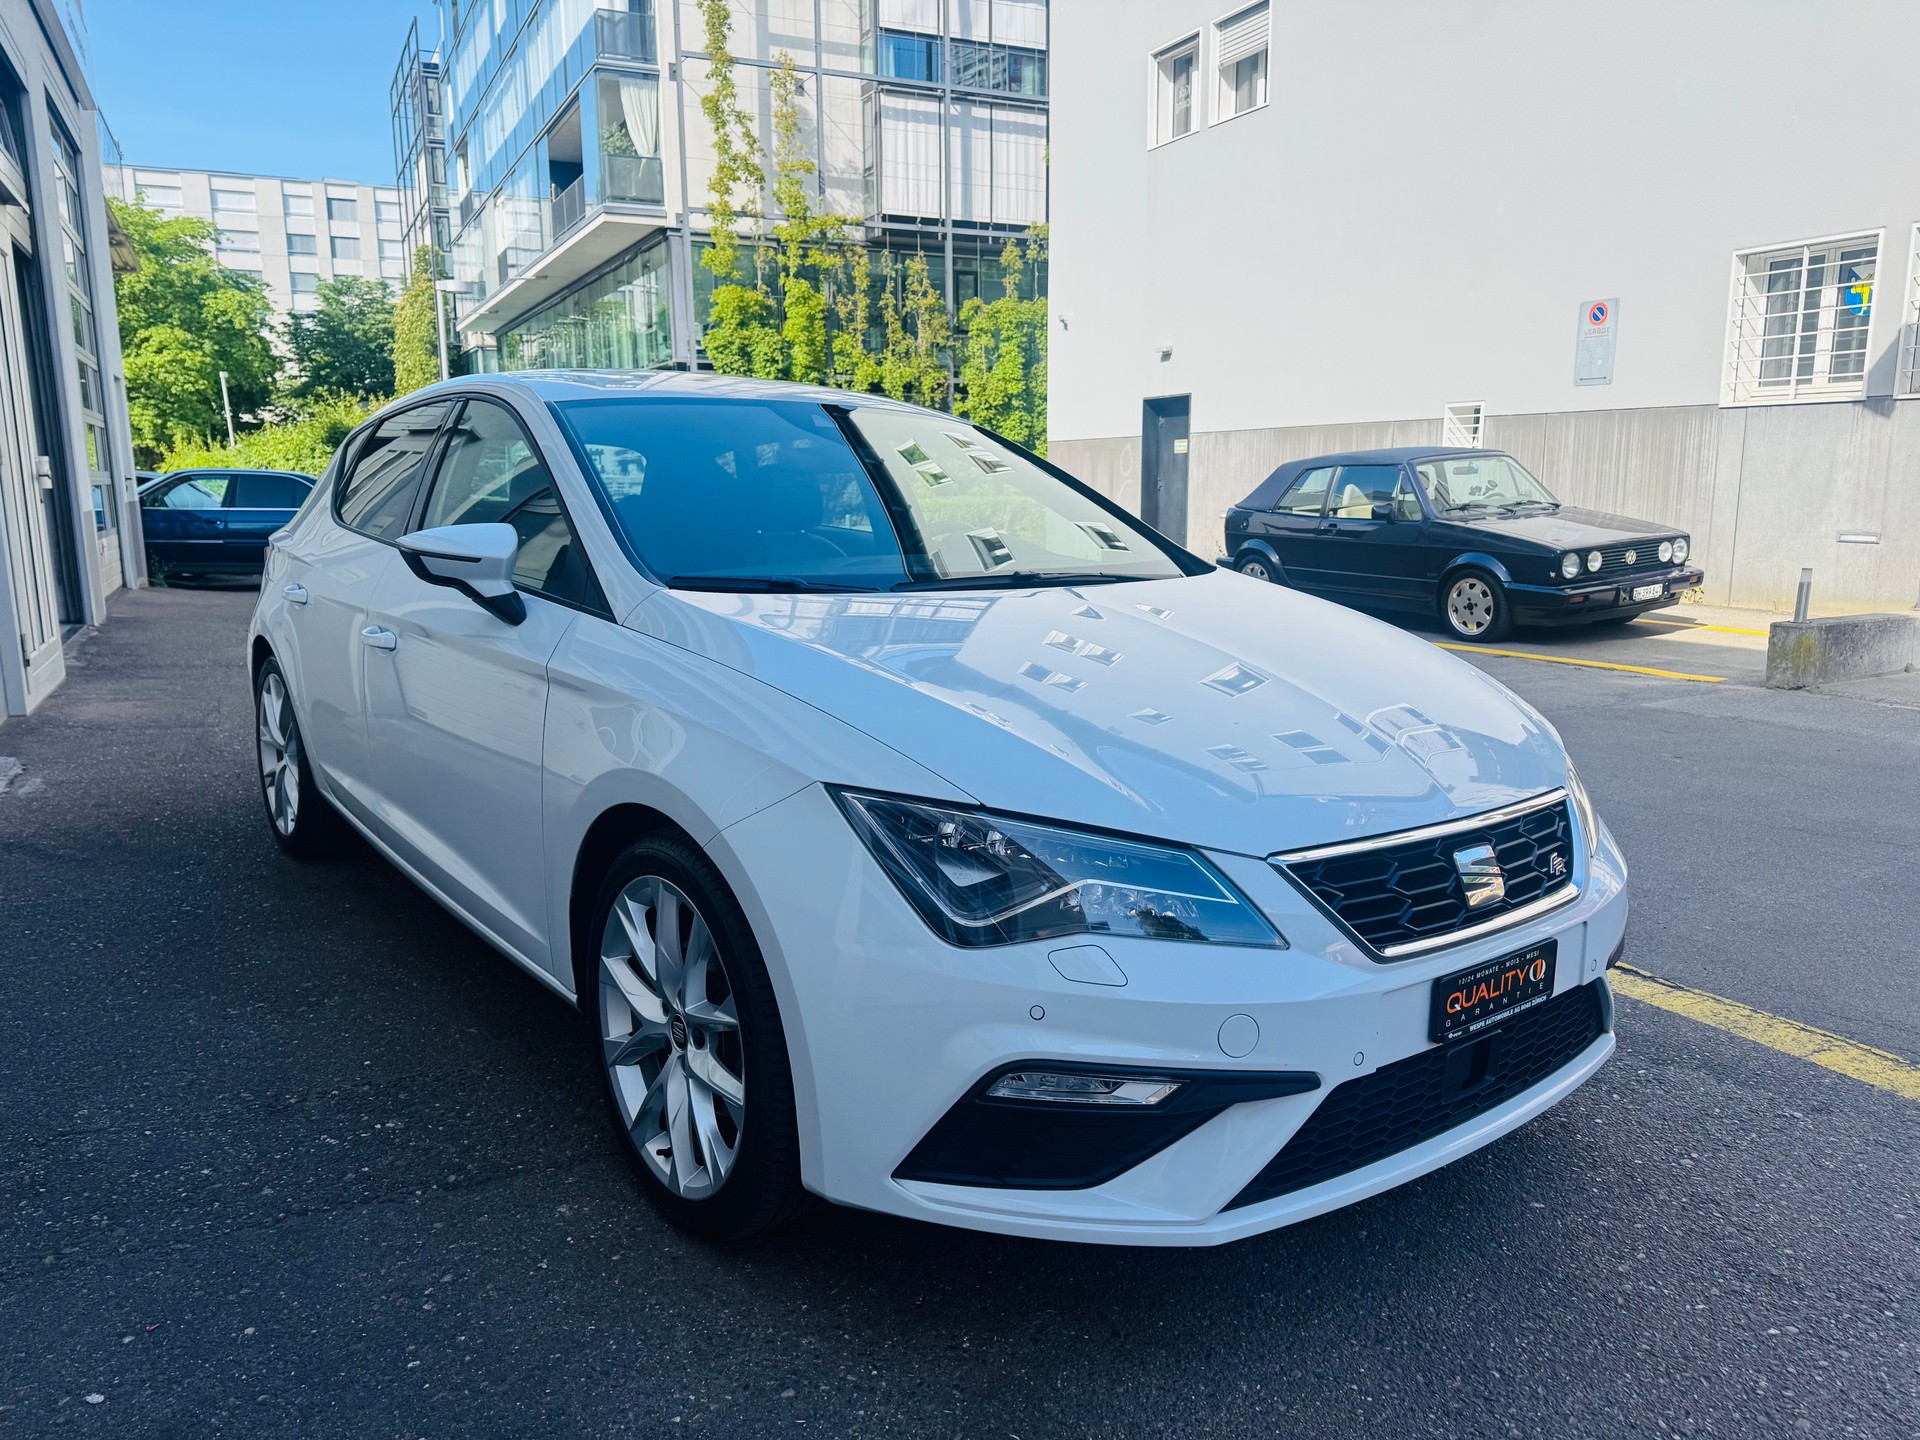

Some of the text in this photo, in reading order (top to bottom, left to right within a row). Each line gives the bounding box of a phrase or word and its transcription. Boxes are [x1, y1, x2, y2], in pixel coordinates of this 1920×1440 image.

[1458, 975, 1475, 986] 12/24
[1476, 965, 1499, 979] MONATE
[1505, 957, 1520, 967] MOIS
[1526, 950, 1540, 960] MESI
[1445, 982, 1545, 1027] GARANTIE
[1447, 965, 1529, 1014] QUALITY
[1469, 1021, 1486, 1032] WESPE
[1486, 1008, 1514, 1025] AUTOMOBILE
